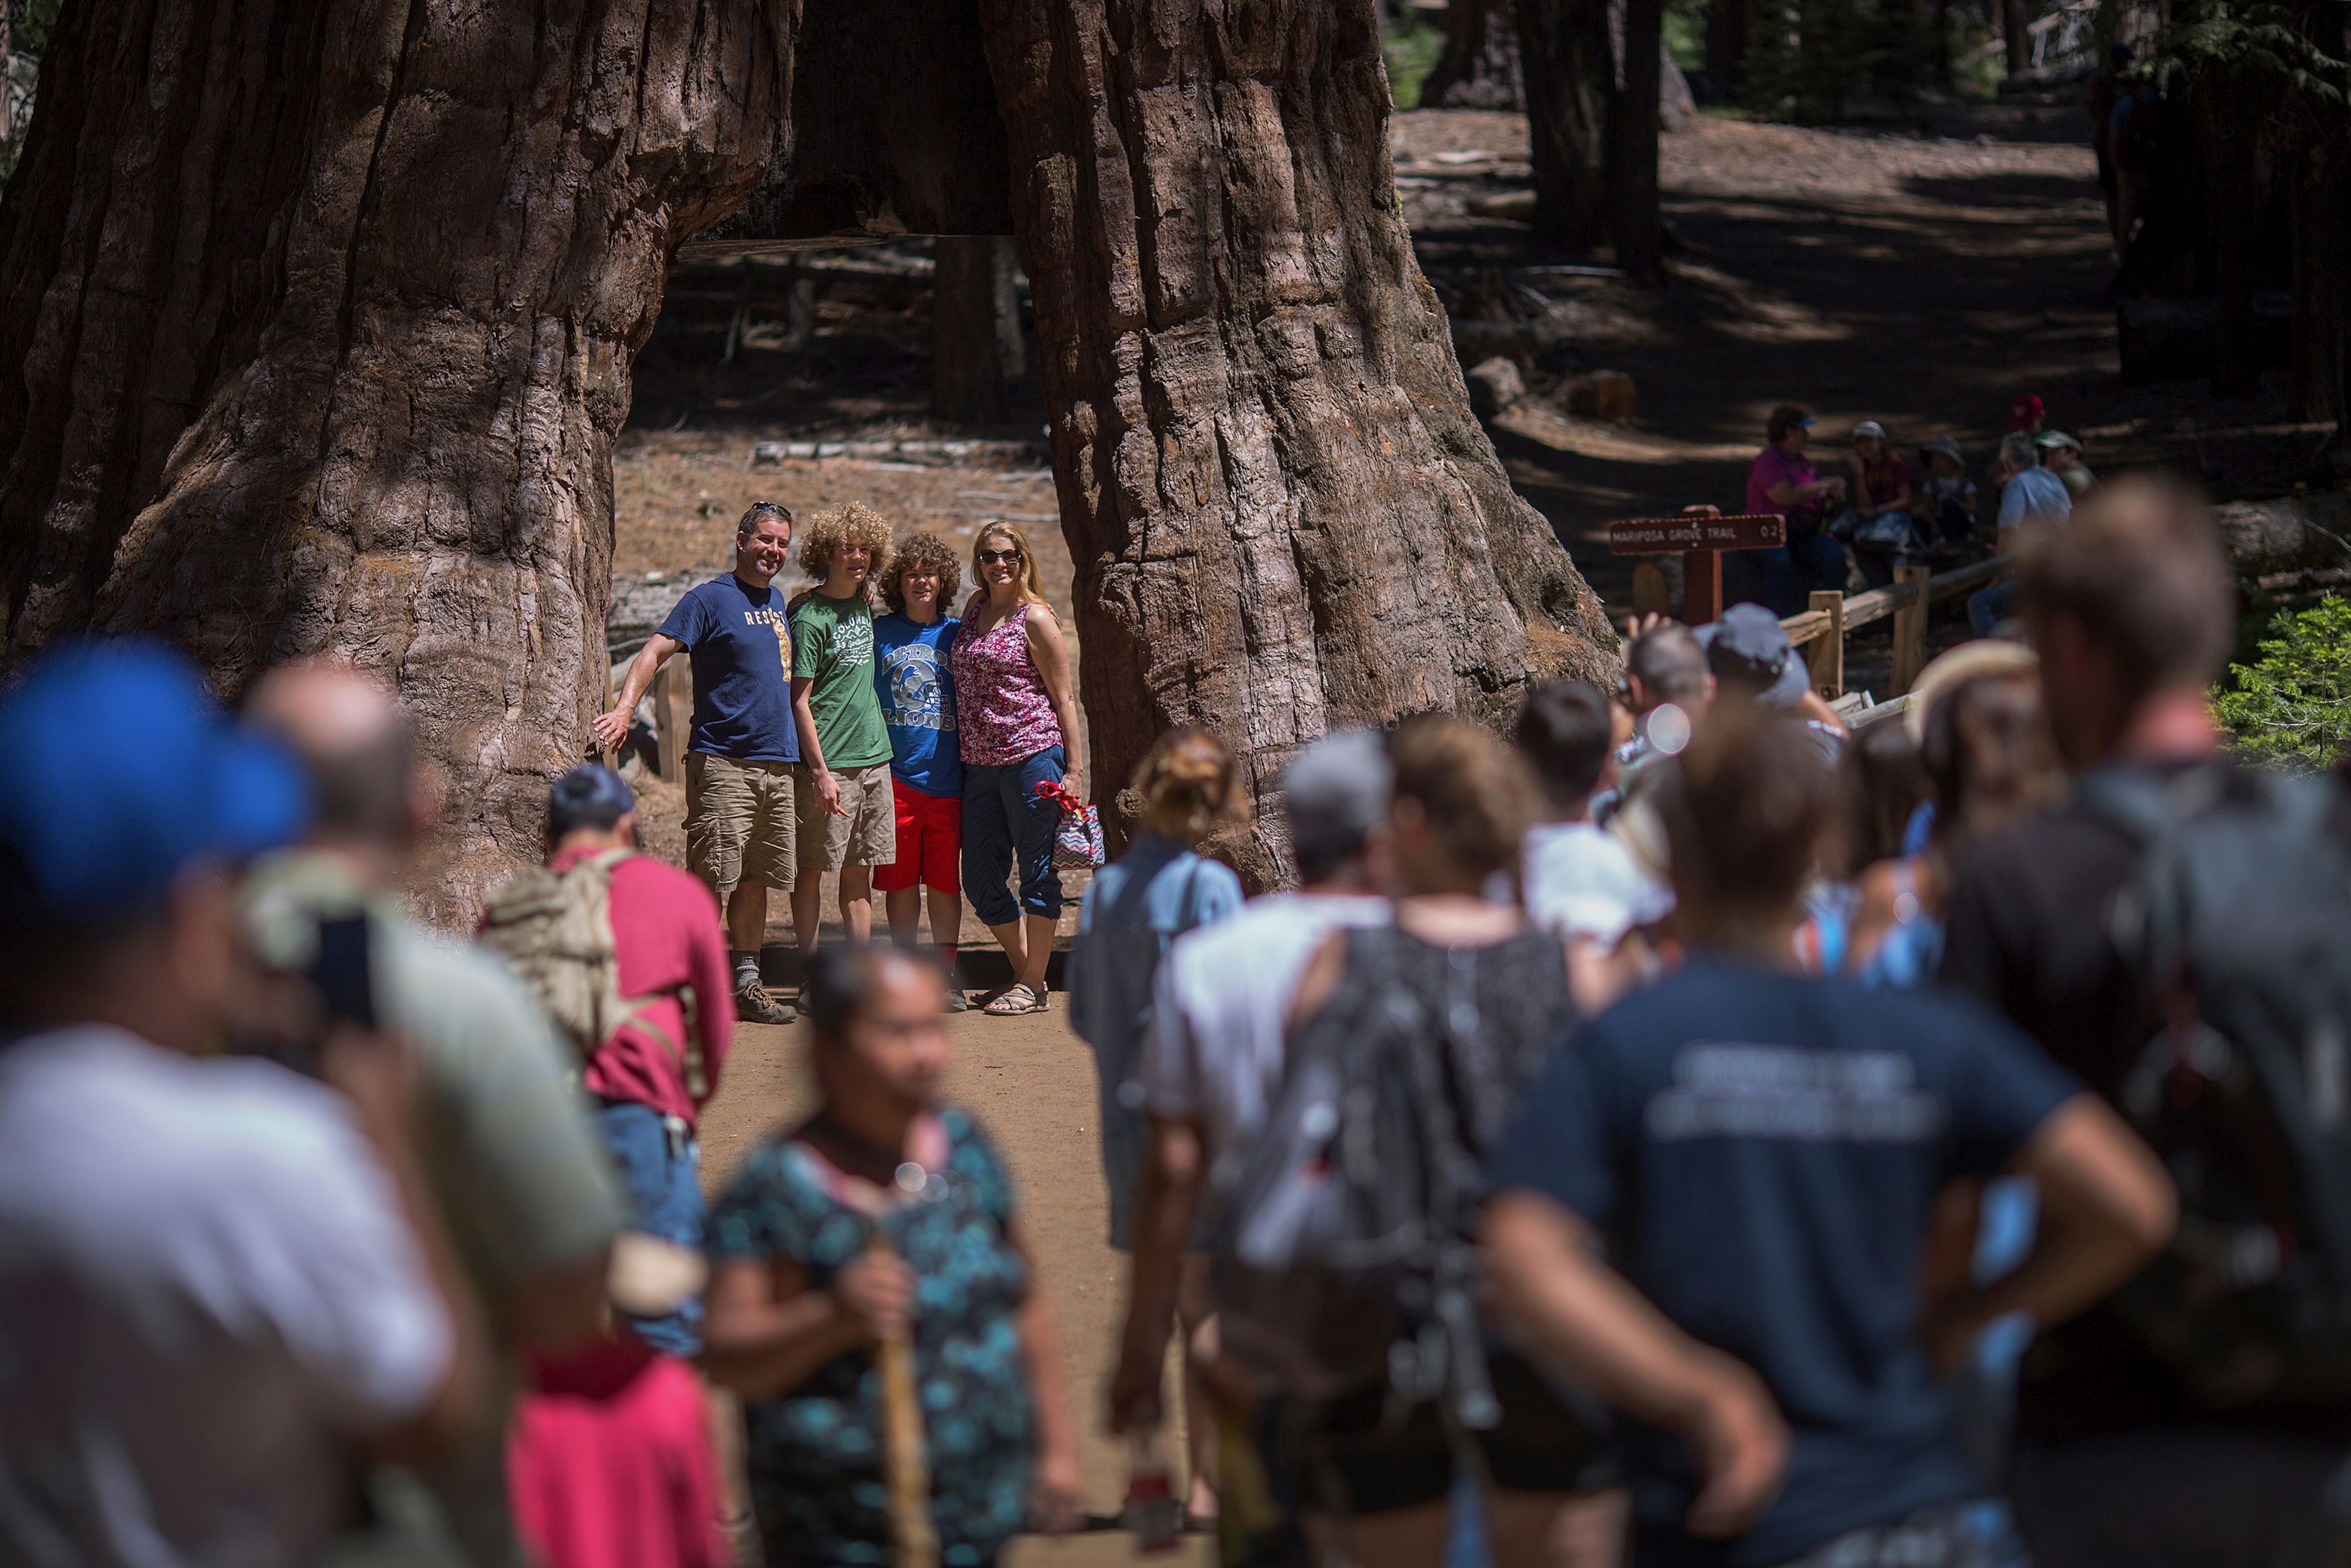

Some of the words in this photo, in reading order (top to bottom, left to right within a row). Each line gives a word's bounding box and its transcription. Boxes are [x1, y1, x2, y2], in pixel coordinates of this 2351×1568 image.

[1613, 530, 1664, 542] MARIPOSA
[1668, 528, 1702, 541] GROVE
[1708, 527, 1736, 539] TRAIL
[833, 615, 871, 639] COLUMBI
[882, 643, 954, 676] DETROI
[882, 708, 956, 731] LIONS
